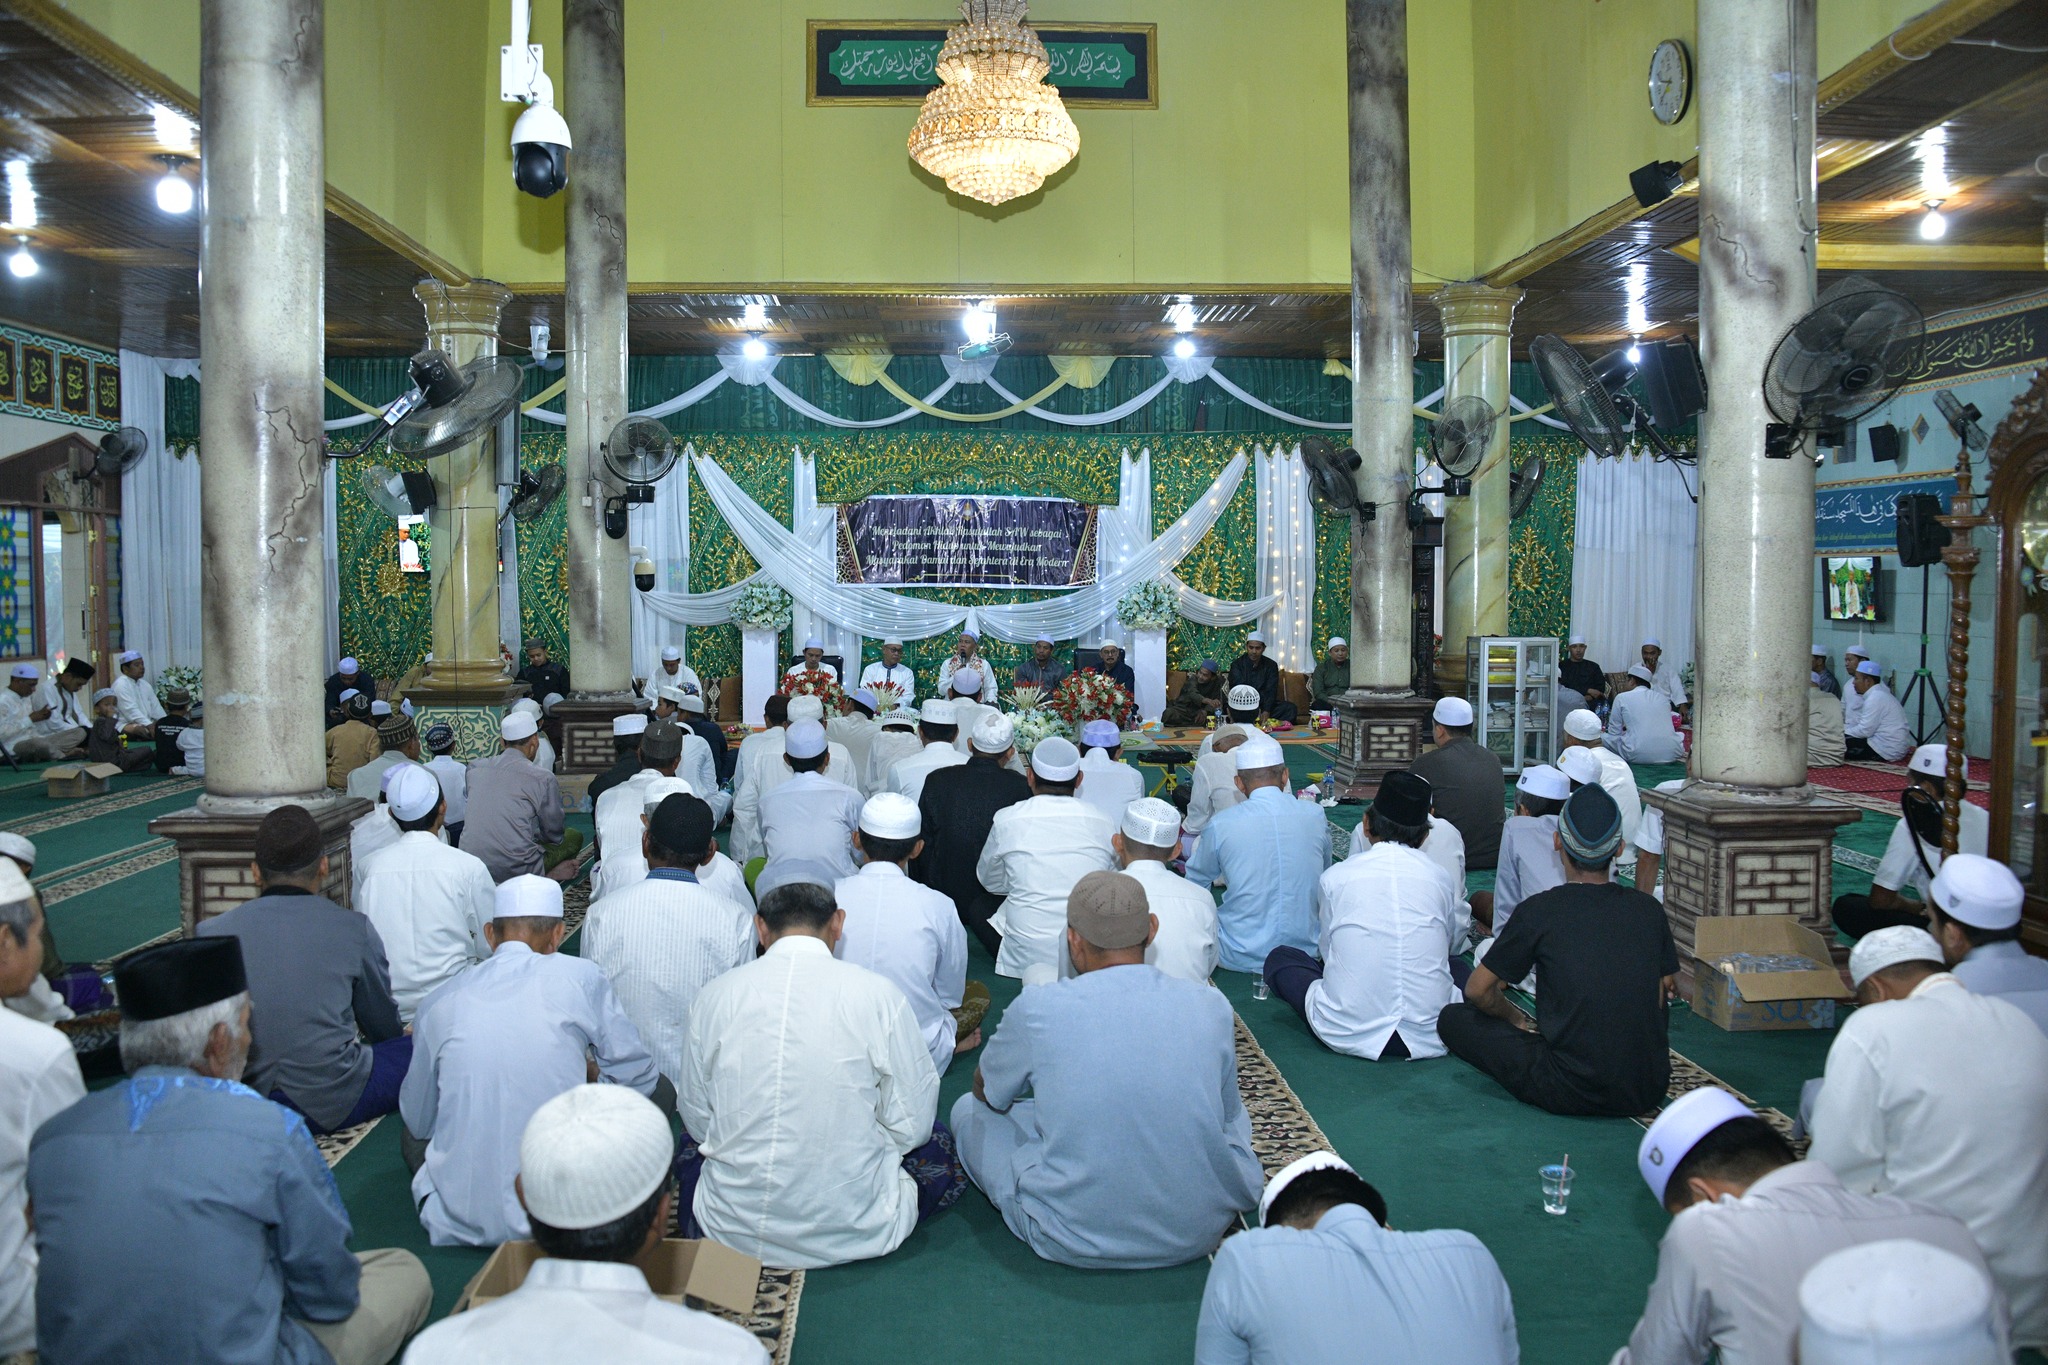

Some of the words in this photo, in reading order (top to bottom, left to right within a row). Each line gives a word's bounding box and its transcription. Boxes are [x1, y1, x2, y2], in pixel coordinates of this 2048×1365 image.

[1004, 527, 1029, 537] SAW
[1030, 528, 1062, 540] sebagai
[892, 540, 931, 551] Pedoman
[987, 541, 1042, 553] Mewujudkan
[866, 555, 917, 567] Masyarakat
[919, 555, 949, 566] Damai
[950, 555, 967, 566] dan
[968, 556, 1008, 567] Sejahtera
[1009, 557, 1018, 566] di
[1020, 557, 1034, 567] Era
[1036, 557, 1069, 568] Modern
